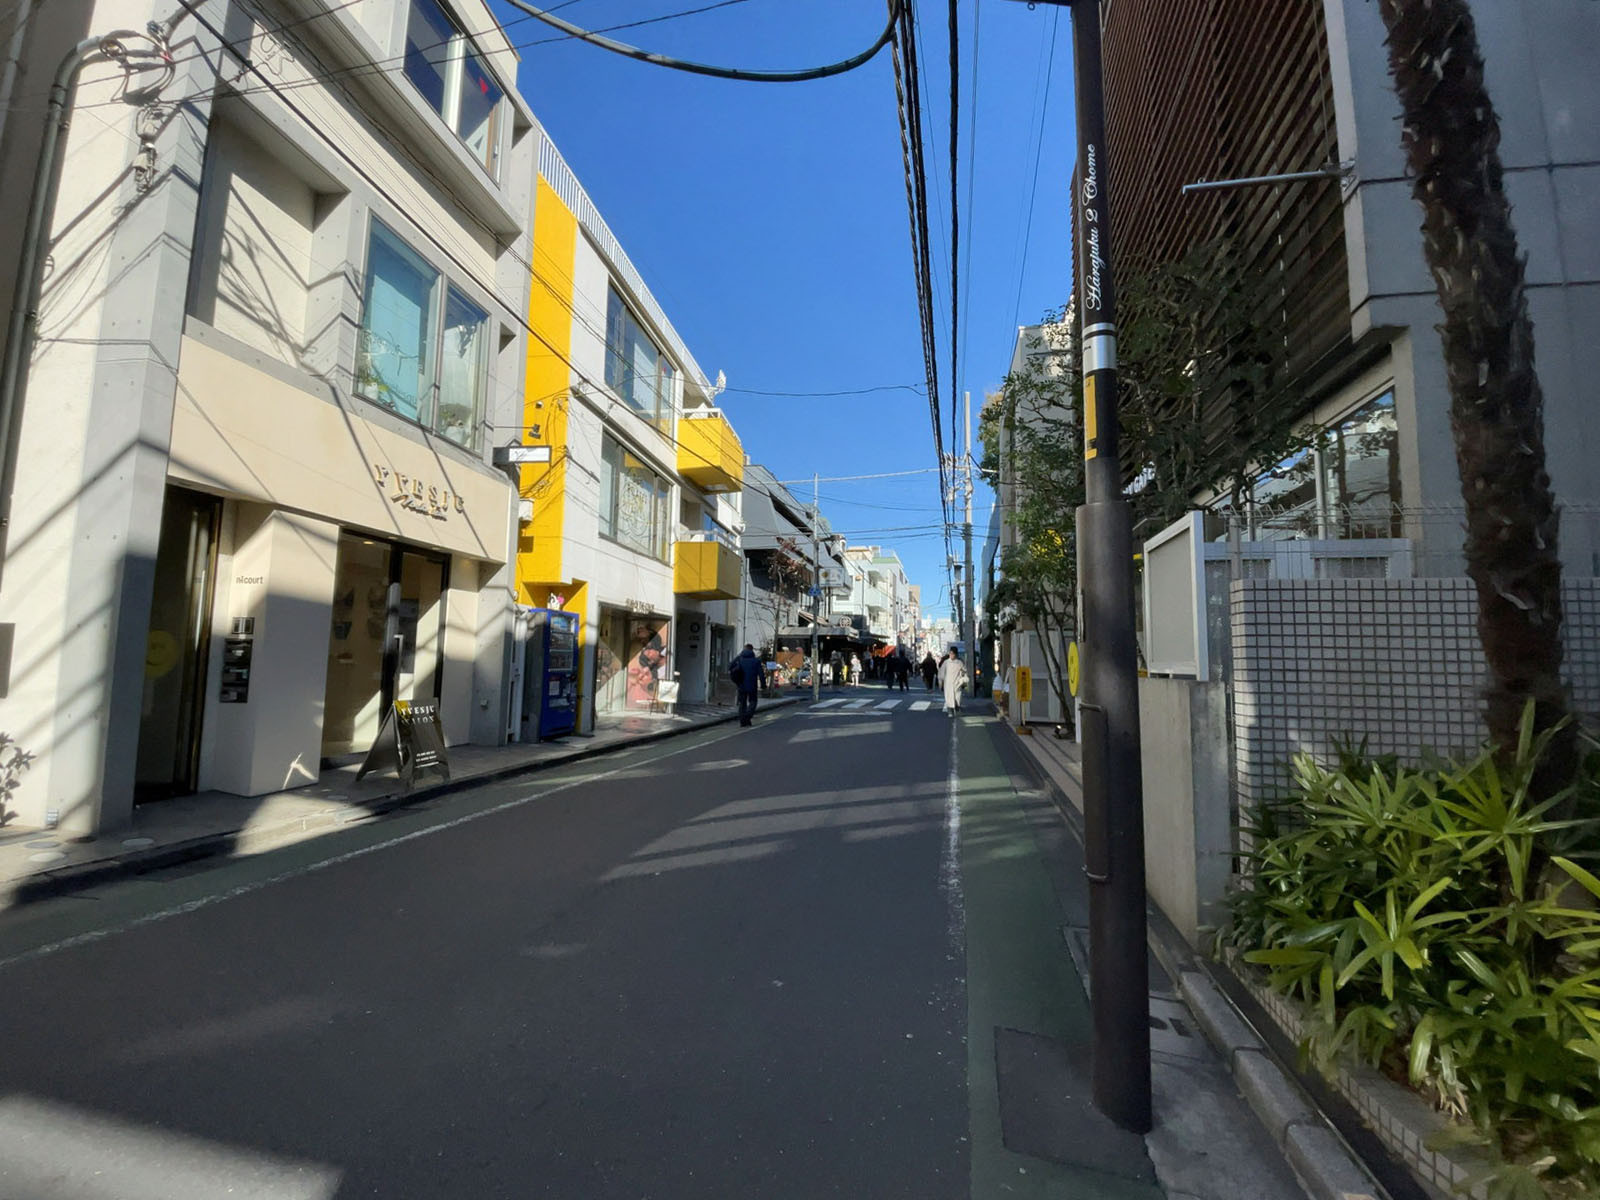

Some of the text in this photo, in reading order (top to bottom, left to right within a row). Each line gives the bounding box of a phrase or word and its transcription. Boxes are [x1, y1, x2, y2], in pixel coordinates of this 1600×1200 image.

[1082, 143, 1106, 311] Harajuku 2 Chome
